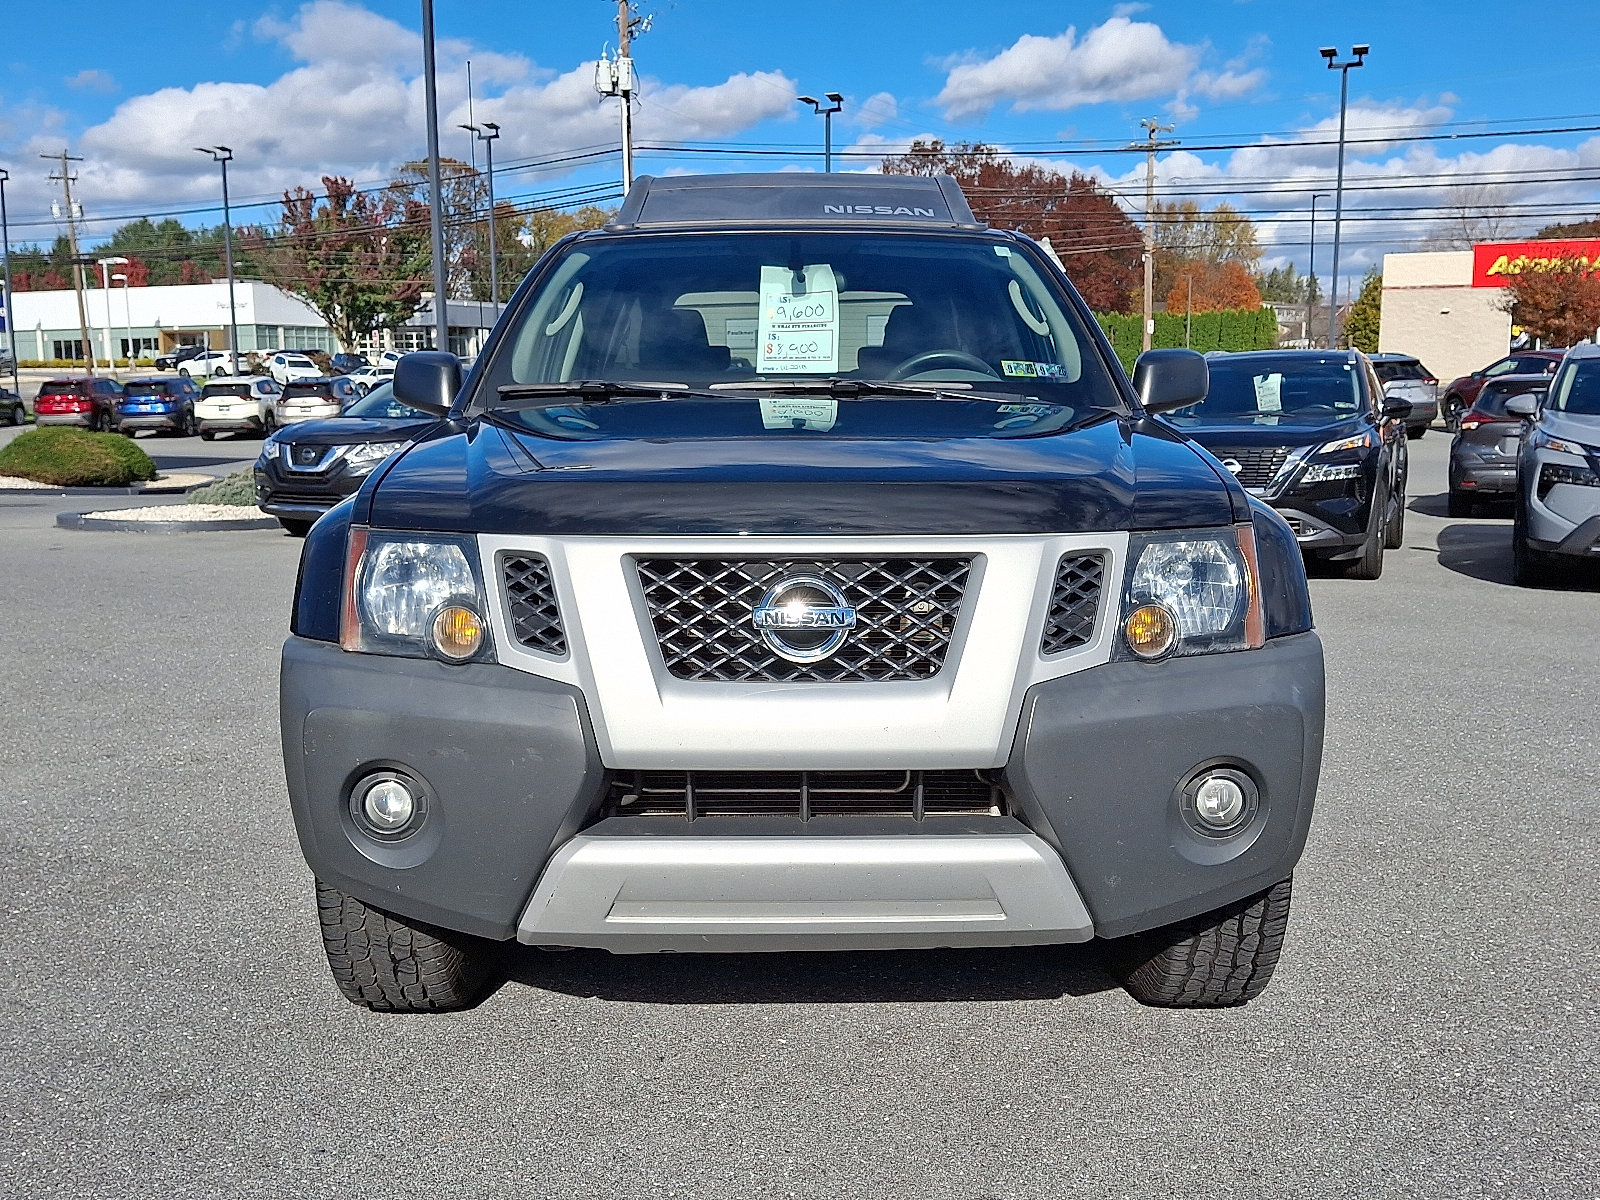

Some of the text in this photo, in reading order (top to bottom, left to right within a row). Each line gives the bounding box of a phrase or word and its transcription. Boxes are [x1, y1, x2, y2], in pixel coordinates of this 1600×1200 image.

[824, 205, 935, 217] NISSAN
[777, 304, 825, 321] 9,600
[764, 611, 845, 625] NISSAN
